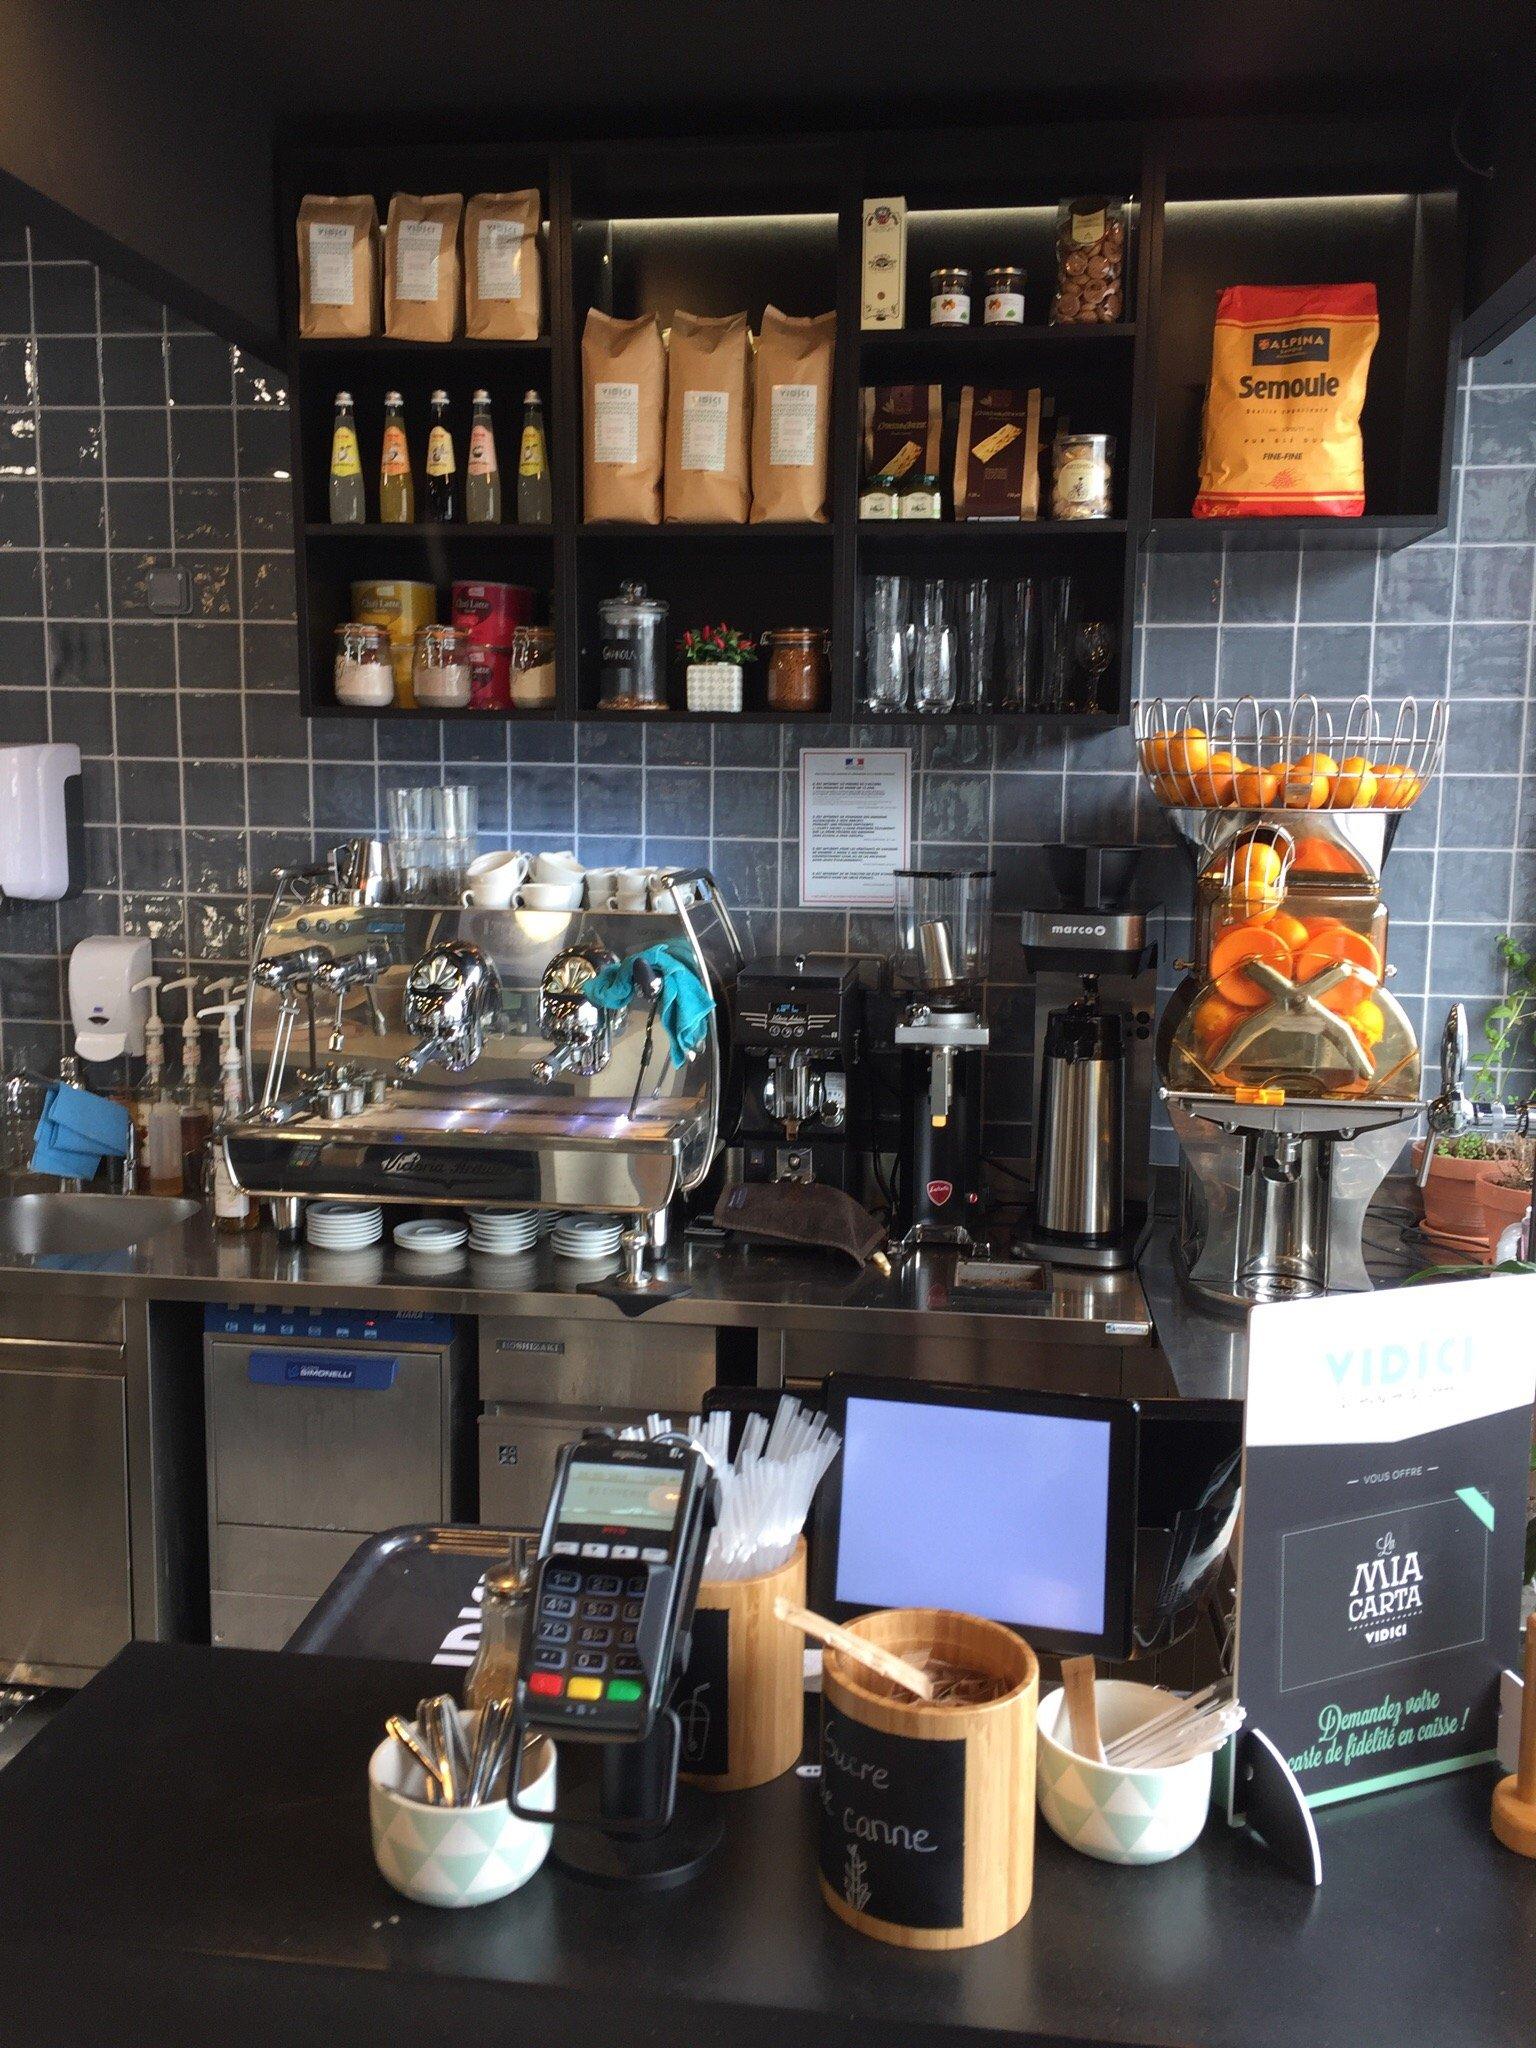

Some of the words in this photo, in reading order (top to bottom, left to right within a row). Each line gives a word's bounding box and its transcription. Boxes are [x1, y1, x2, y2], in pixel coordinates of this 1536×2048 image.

[1270, 335, 1324, 349] ALPINA
[1239, 373, 1339, 399] Semoule
[1052, 925, 1093, 934] marco
[300, 1368, 353, 1379] SIMONELLI
[1326, 1335, 1472, 1385] VIDICI
[1363, 1471, 1390, 1484] VOUS
[1392, 1466, 1422, 1480] OFFRE
[1350, 1551, 1423, 1597] MIA
[1349, 1585, 1423, 1622] CARTA
[1365, 1623, 1407, 1643] VIDICI
[1318, 1695, 1401, 1743] Demandez
[1405, 1689, 1440, 1715] votre
[825, 1720, 890, 1790] Sucre
[1288, 1745, 1323, 1773] carte
[1325, 1737, 1343, 1764] de
[1344, 1727, 1396, 1766] fidélité
[1398, 1728, 1415, 1747] en
[1417, 1716, 1459, 1741] caisse
